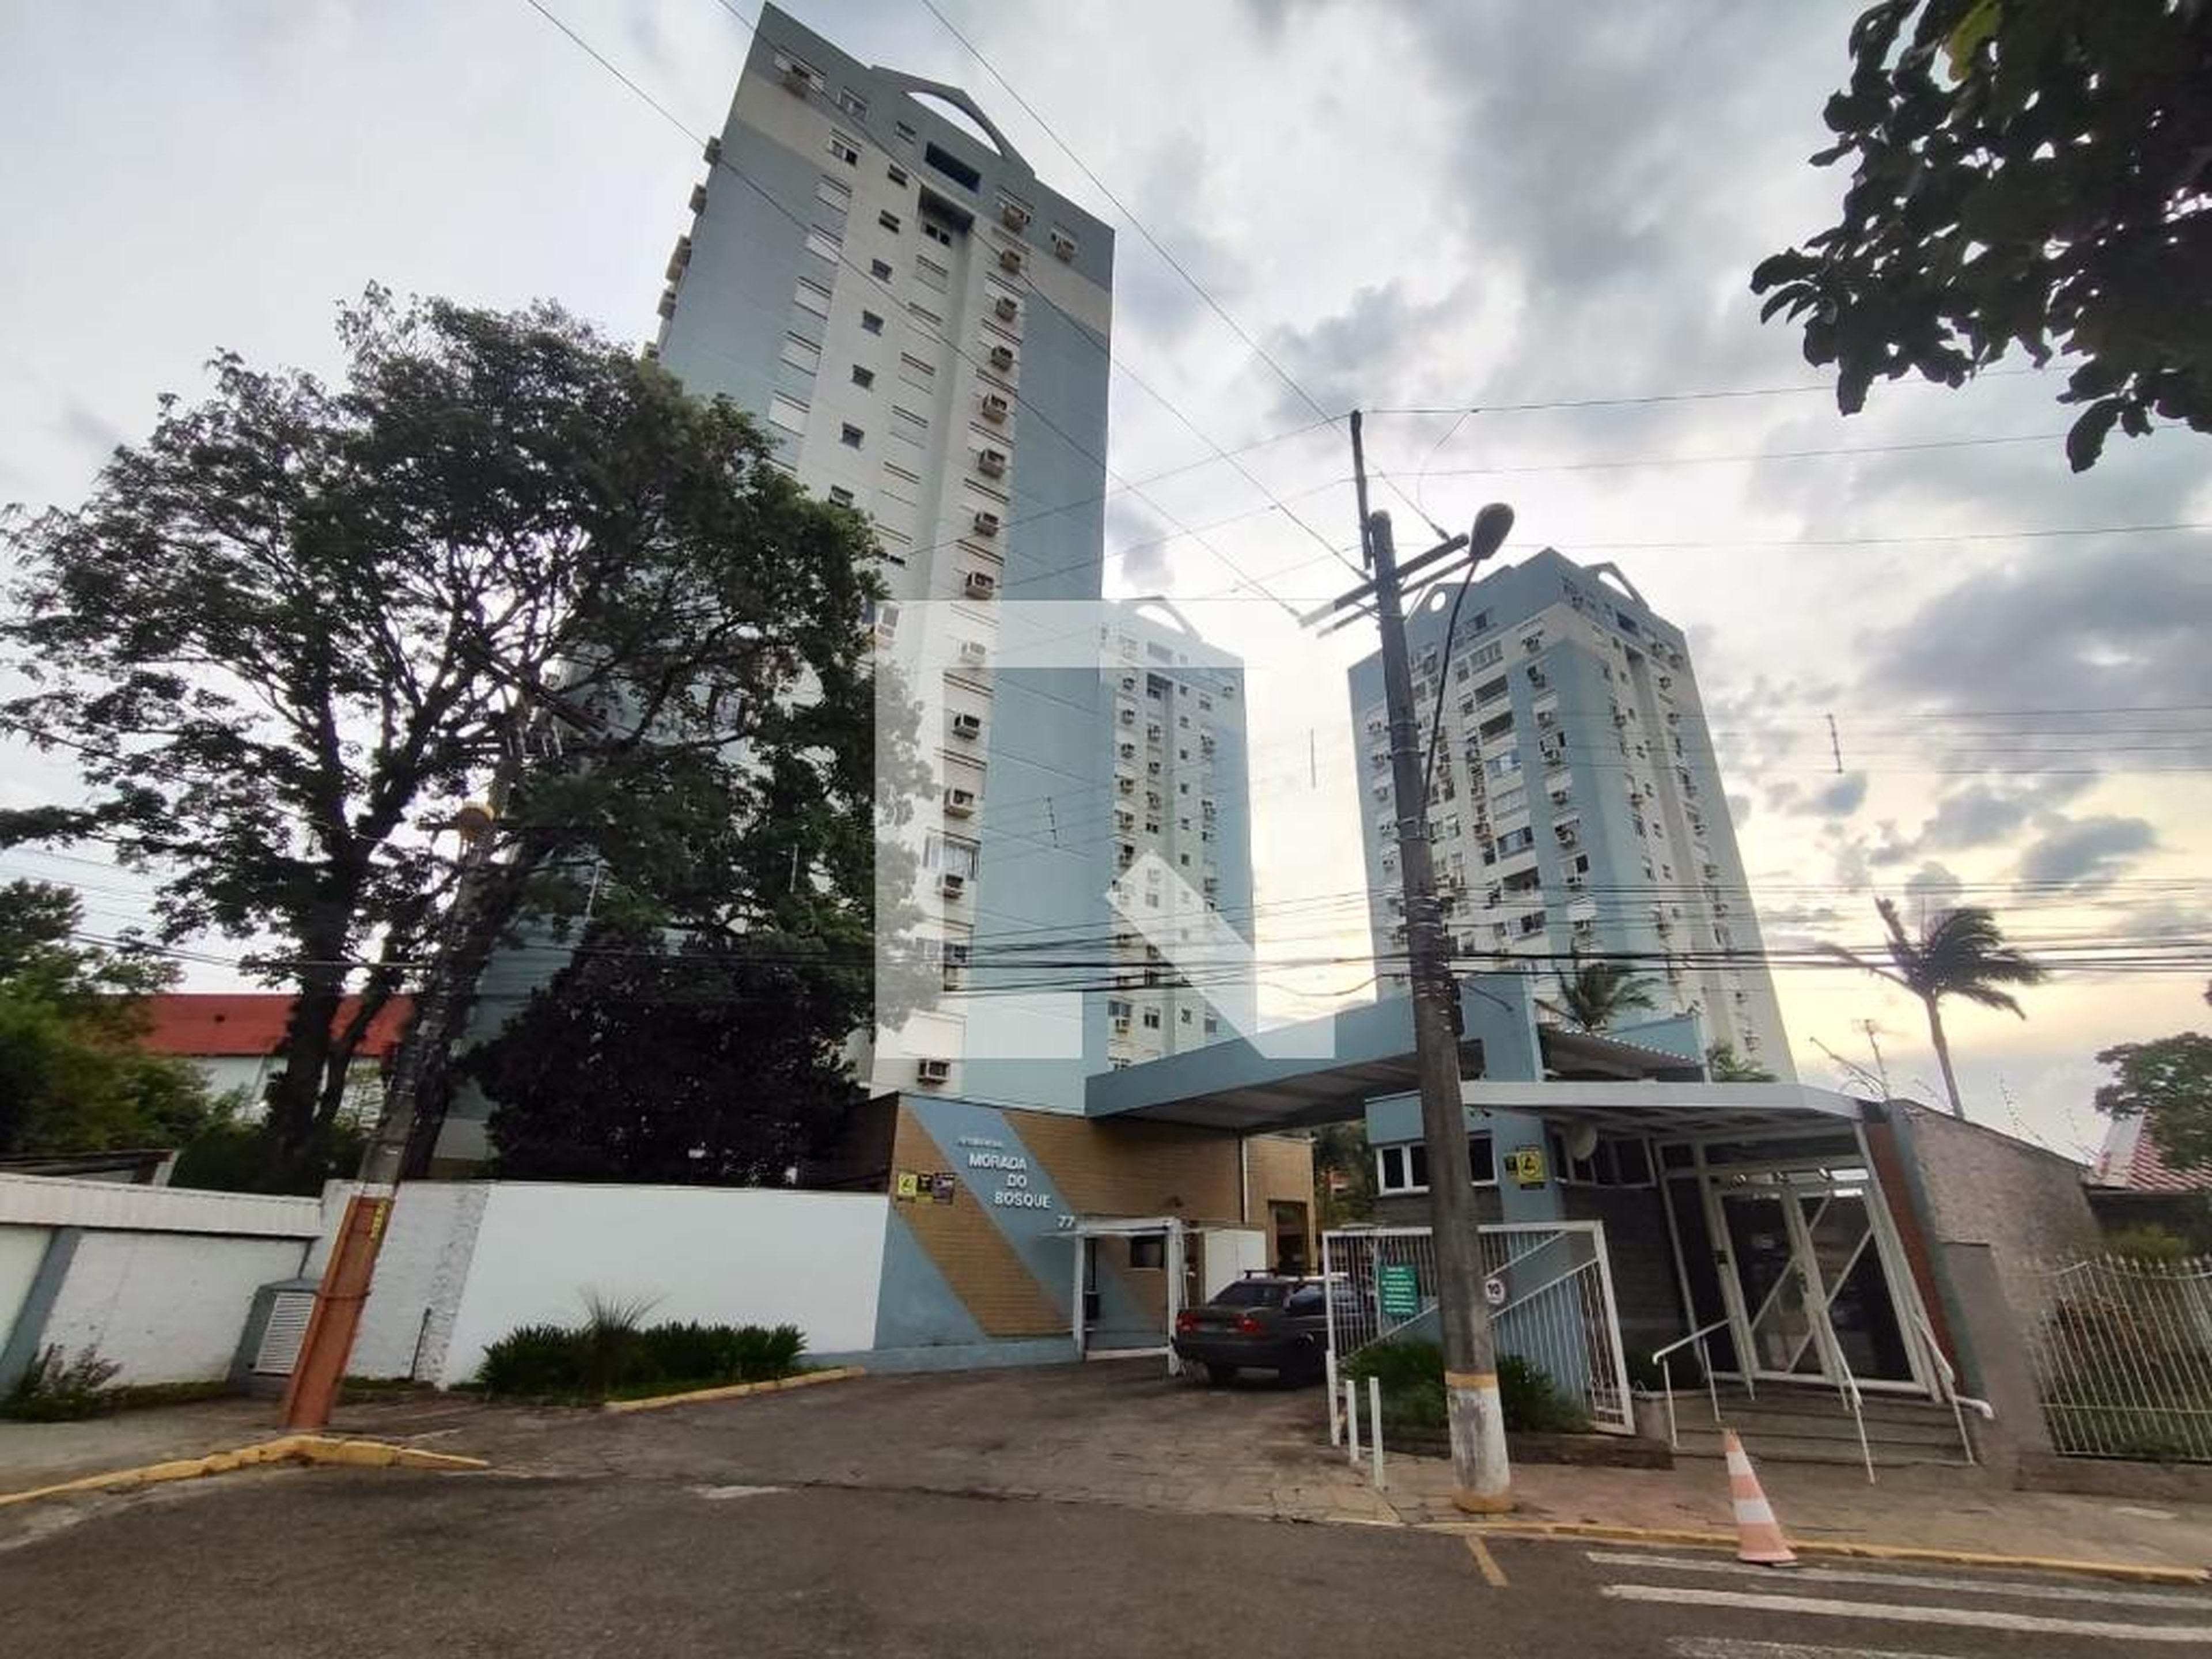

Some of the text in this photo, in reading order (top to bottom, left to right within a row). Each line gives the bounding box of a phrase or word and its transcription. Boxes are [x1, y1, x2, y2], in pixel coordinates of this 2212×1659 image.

[969, 1153, 1027, 1171] MORADA
[1007, 1173, 1027, 1188] DO
[994, 1191, 1052, 1209] BOSQUE
